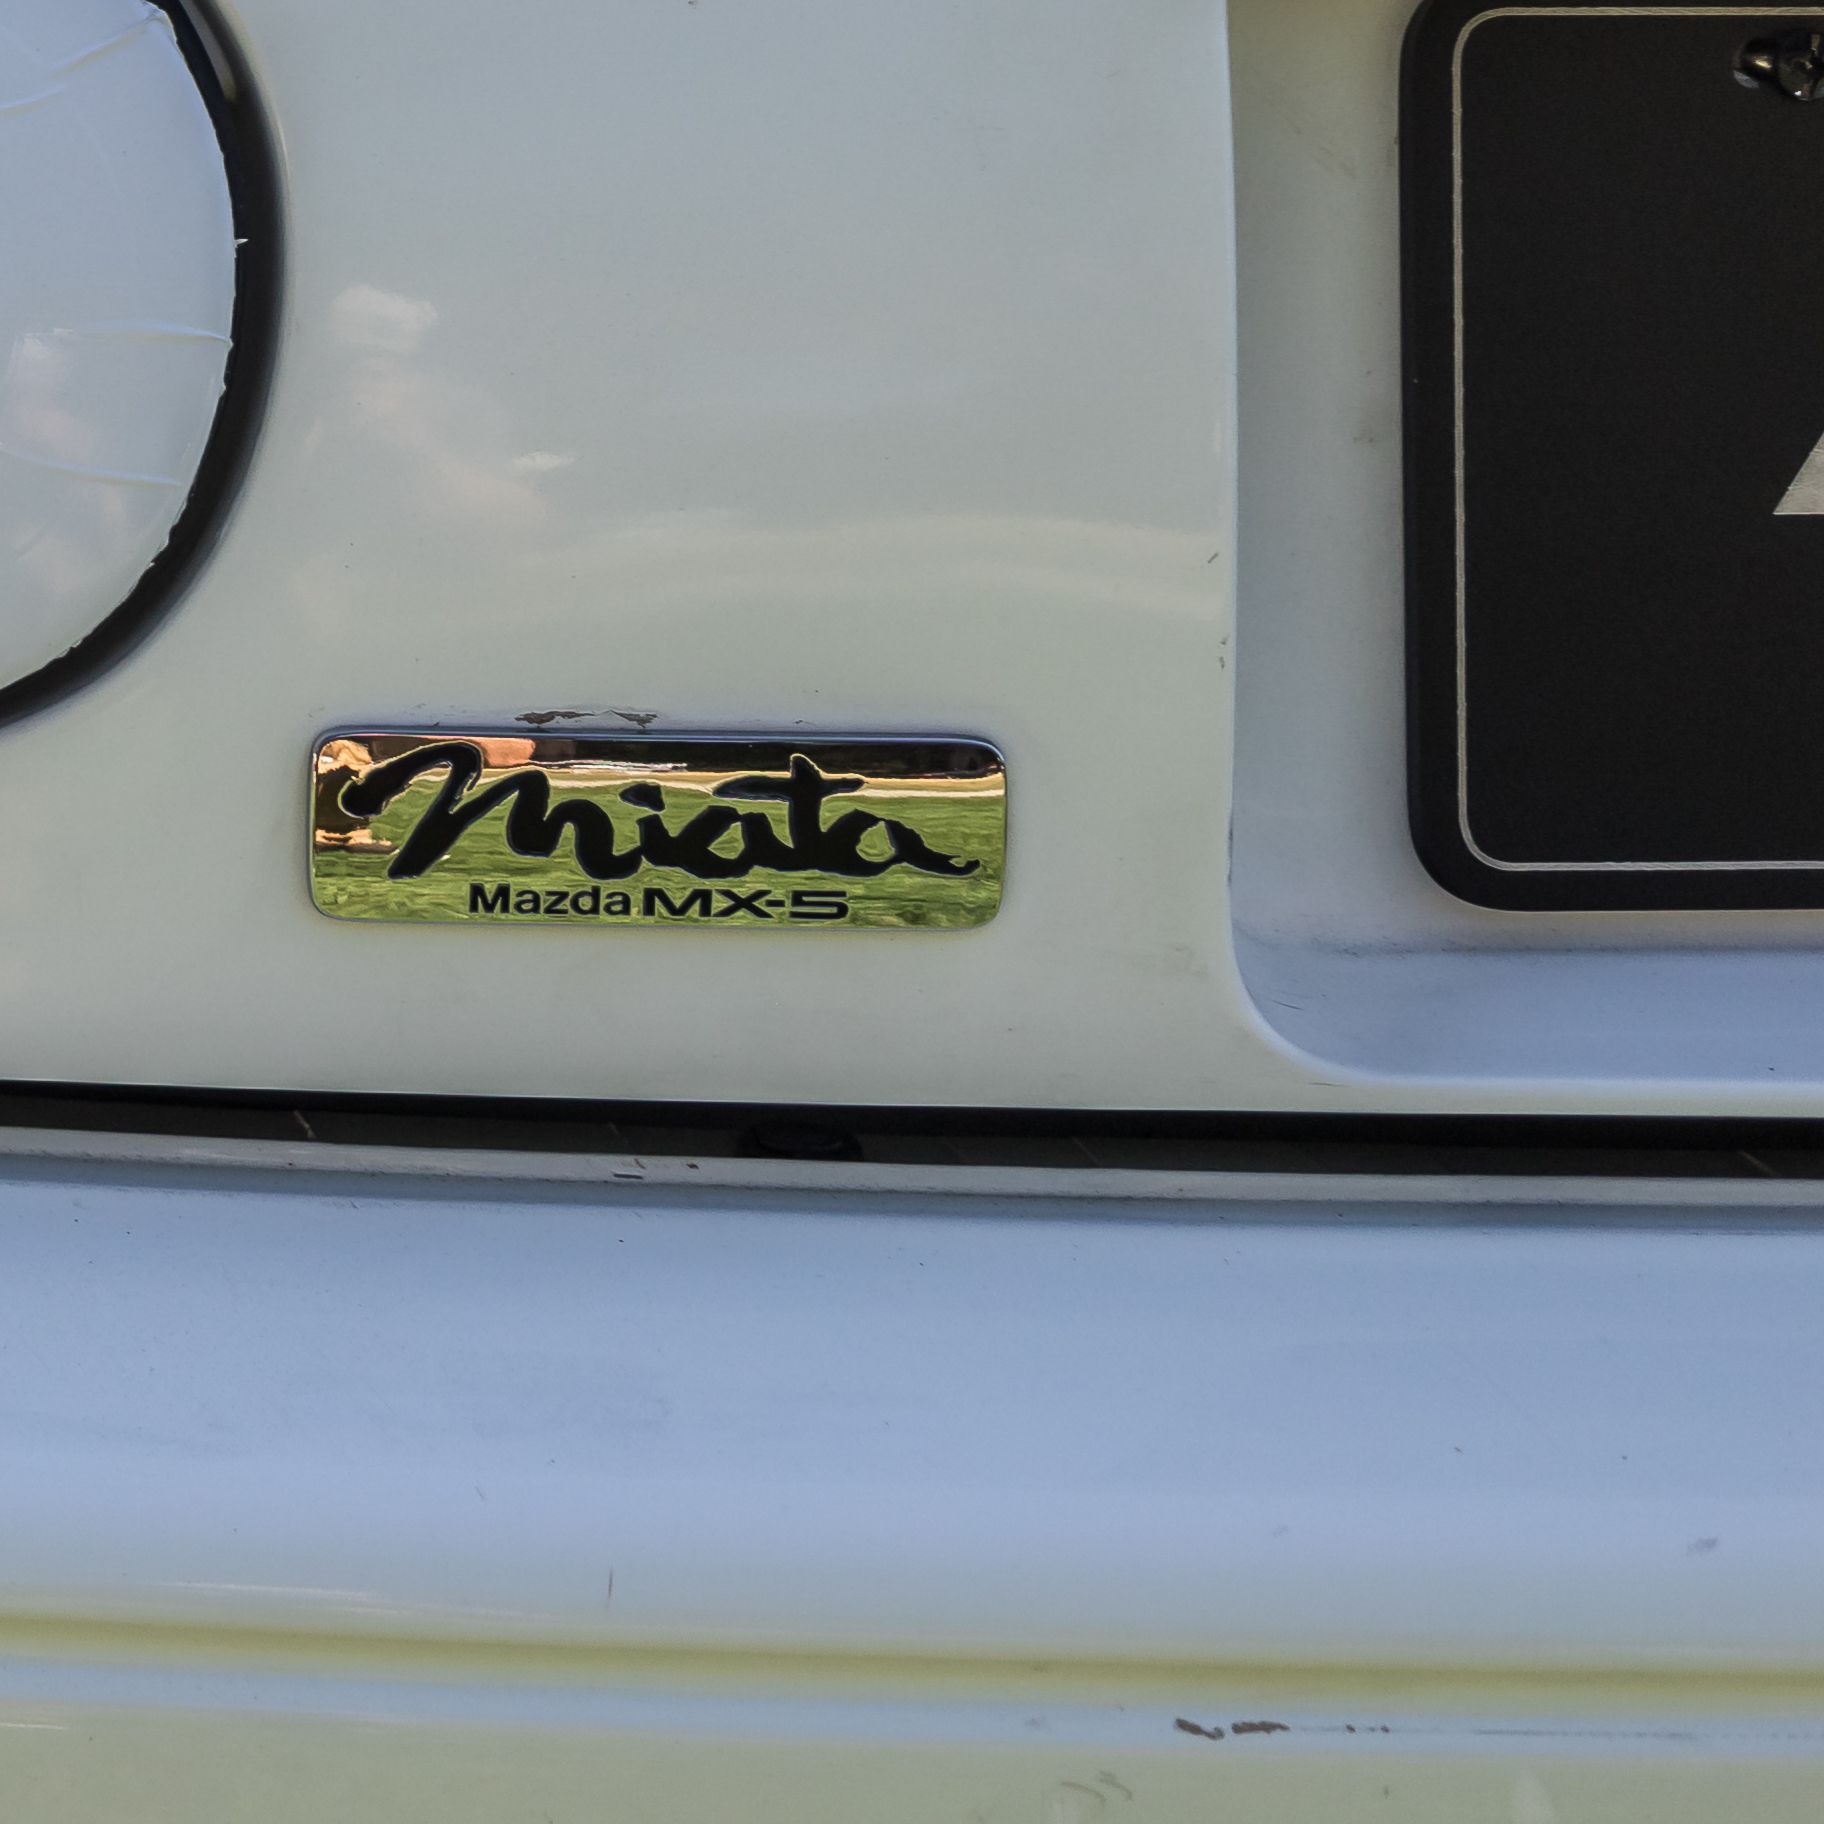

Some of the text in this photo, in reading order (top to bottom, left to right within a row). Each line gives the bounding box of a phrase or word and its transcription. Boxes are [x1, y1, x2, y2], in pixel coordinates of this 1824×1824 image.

[339, 741, 981, 880] Miata
[468, 882, 849, 920] Mazda MX-5
